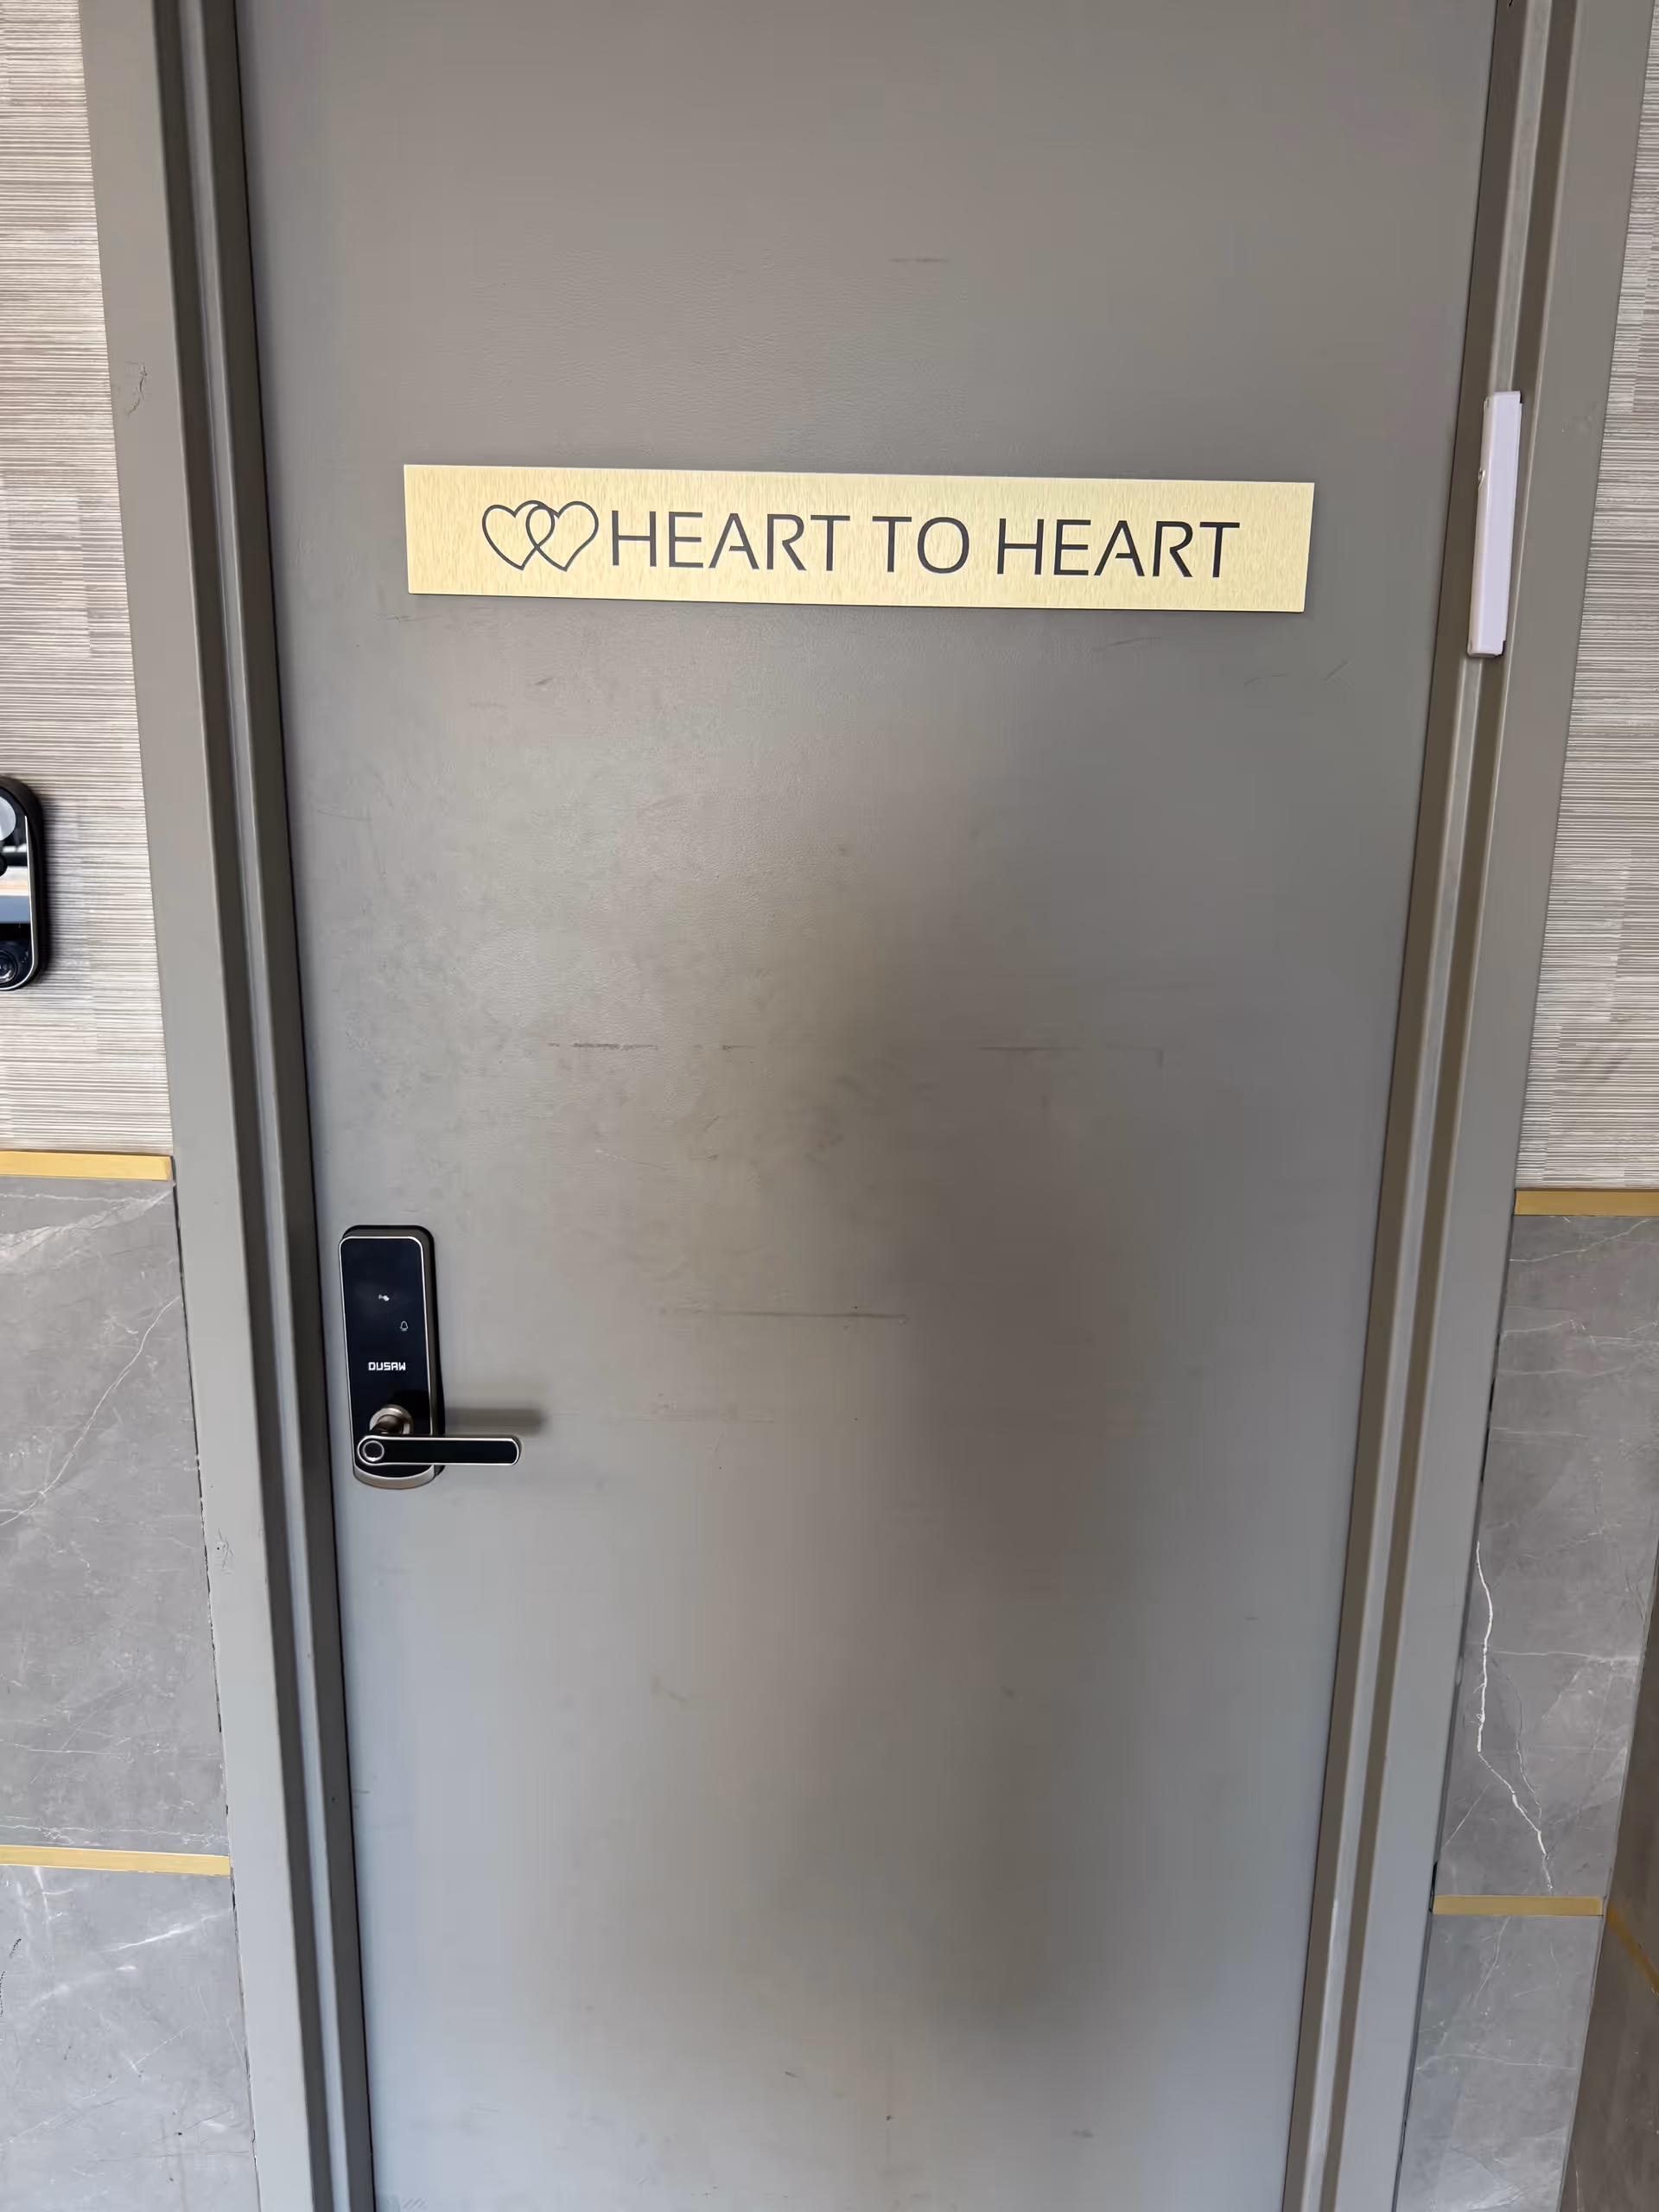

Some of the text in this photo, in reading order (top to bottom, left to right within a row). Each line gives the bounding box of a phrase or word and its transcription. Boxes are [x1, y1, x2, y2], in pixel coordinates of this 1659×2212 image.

[611, 510, 1241, 578] HEART TO HEART
